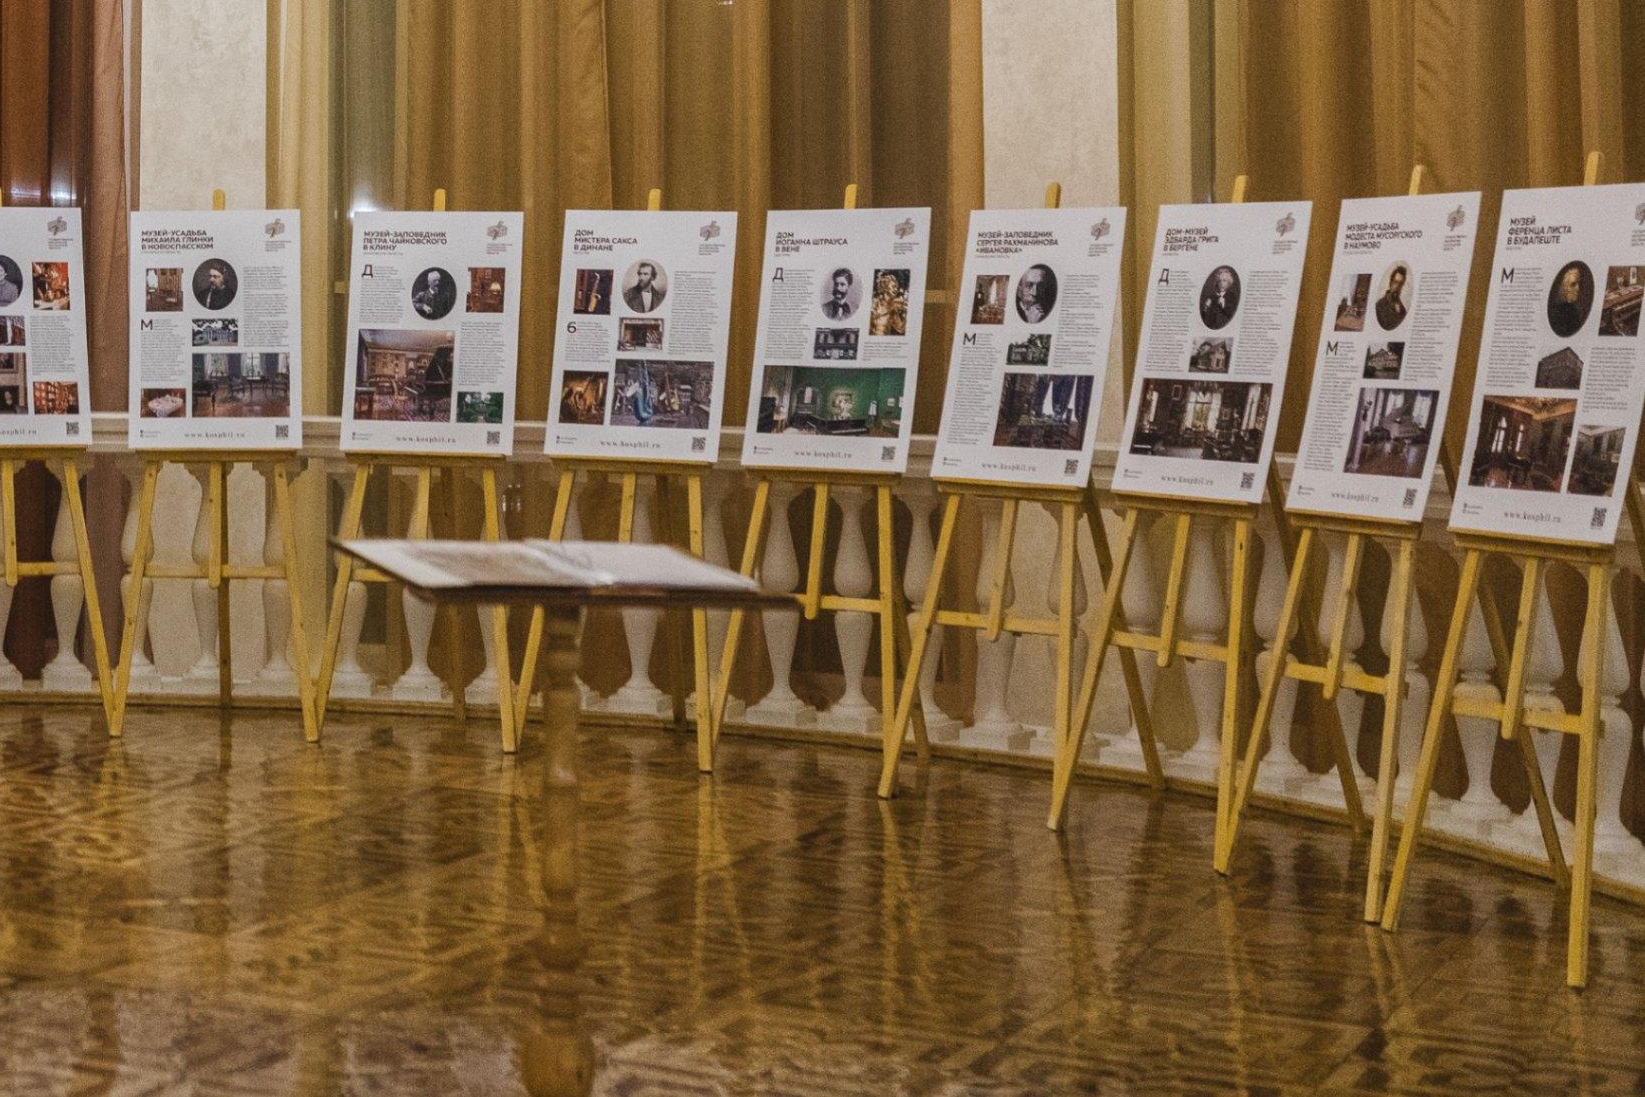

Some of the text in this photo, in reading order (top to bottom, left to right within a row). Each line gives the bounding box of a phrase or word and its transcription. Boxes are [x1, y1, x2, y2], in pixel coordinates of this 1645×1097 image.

[1510, 216, 1536, 226] МУЗЕЙ
[1166, 226, 1209, 236] ДОМ-МУЗЕЙ
[1346, 222, 1399, 232] МУЗЕЙ-УСАДЬБА
[1508, 225, 1573, 236] ФЕРЕНЦА ЛИСТА
[141, 229, 207, 237] МУЗЕЙ-УСАДЬБА
[363, 230, 447, 239] МУЗЕЙ-ЗАПОВЕДНИК
[574, 229, 594, 237] ДОМ
[978, 230, 1054, 239] МУЗЕЙ-ЗАПОВЕДНИК
[1345, 232, 1375, 240] МОДЕСТА
[389, 237, 448, 245] ЧАЙКОВСКОГО
[812, 238, 848, 246] ШТРАУСА
[1004, 238, 1059, 246] РАХМАНИНОВА
[1507, 235, 1561, 245] В БУДАПЕШТЕ
[580, 244, 613, 252] ДИНАНЕ
[1169, 244, 1199, 252] БЕРГЕНЕ
